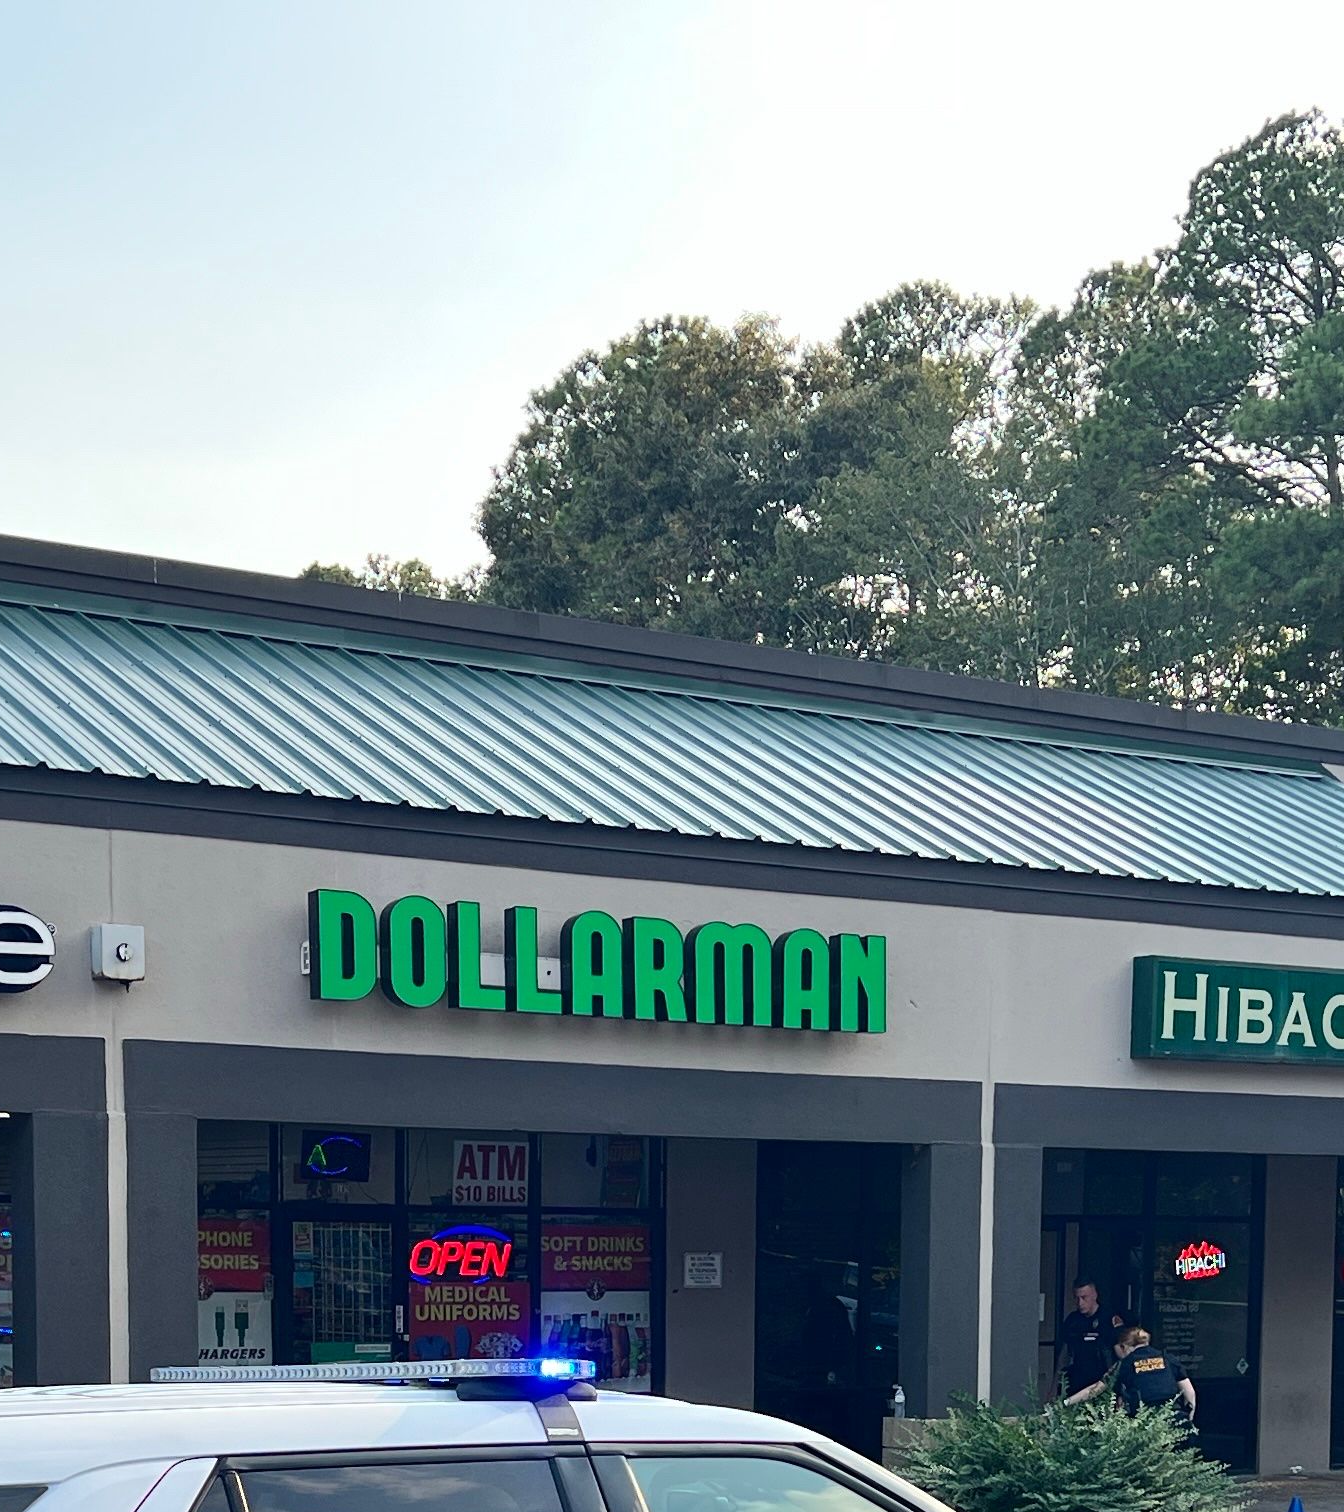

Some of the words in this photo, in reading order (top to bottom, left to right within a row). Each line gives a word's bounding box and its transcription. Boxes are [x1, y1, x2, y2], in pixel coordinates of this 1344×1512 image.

[309, 889, 886, 1033] DOLLARMAN
[456, 1143, 526, 1181] ATM
[455, 1185, 482, 1203] $10
[486, 1185, 526, 1203] BILLS
[540, 1236, 584, 1252] SOFT
[587, 1236, 645, 1253] DRINKS
[199, 1254, 260, 1270] SORIES
[409, 1239, 512, 1277] OPEN
[571, 1256, 634, 1271] SNACKS
[1175, 1252, 1226, 1275] HIBACHI
[424, 1286, 511, 1303] MEDICAL
[415, 1304, 521, 1321] UNIFORMS
[198, 1348, 266, 1360] HARGERS
